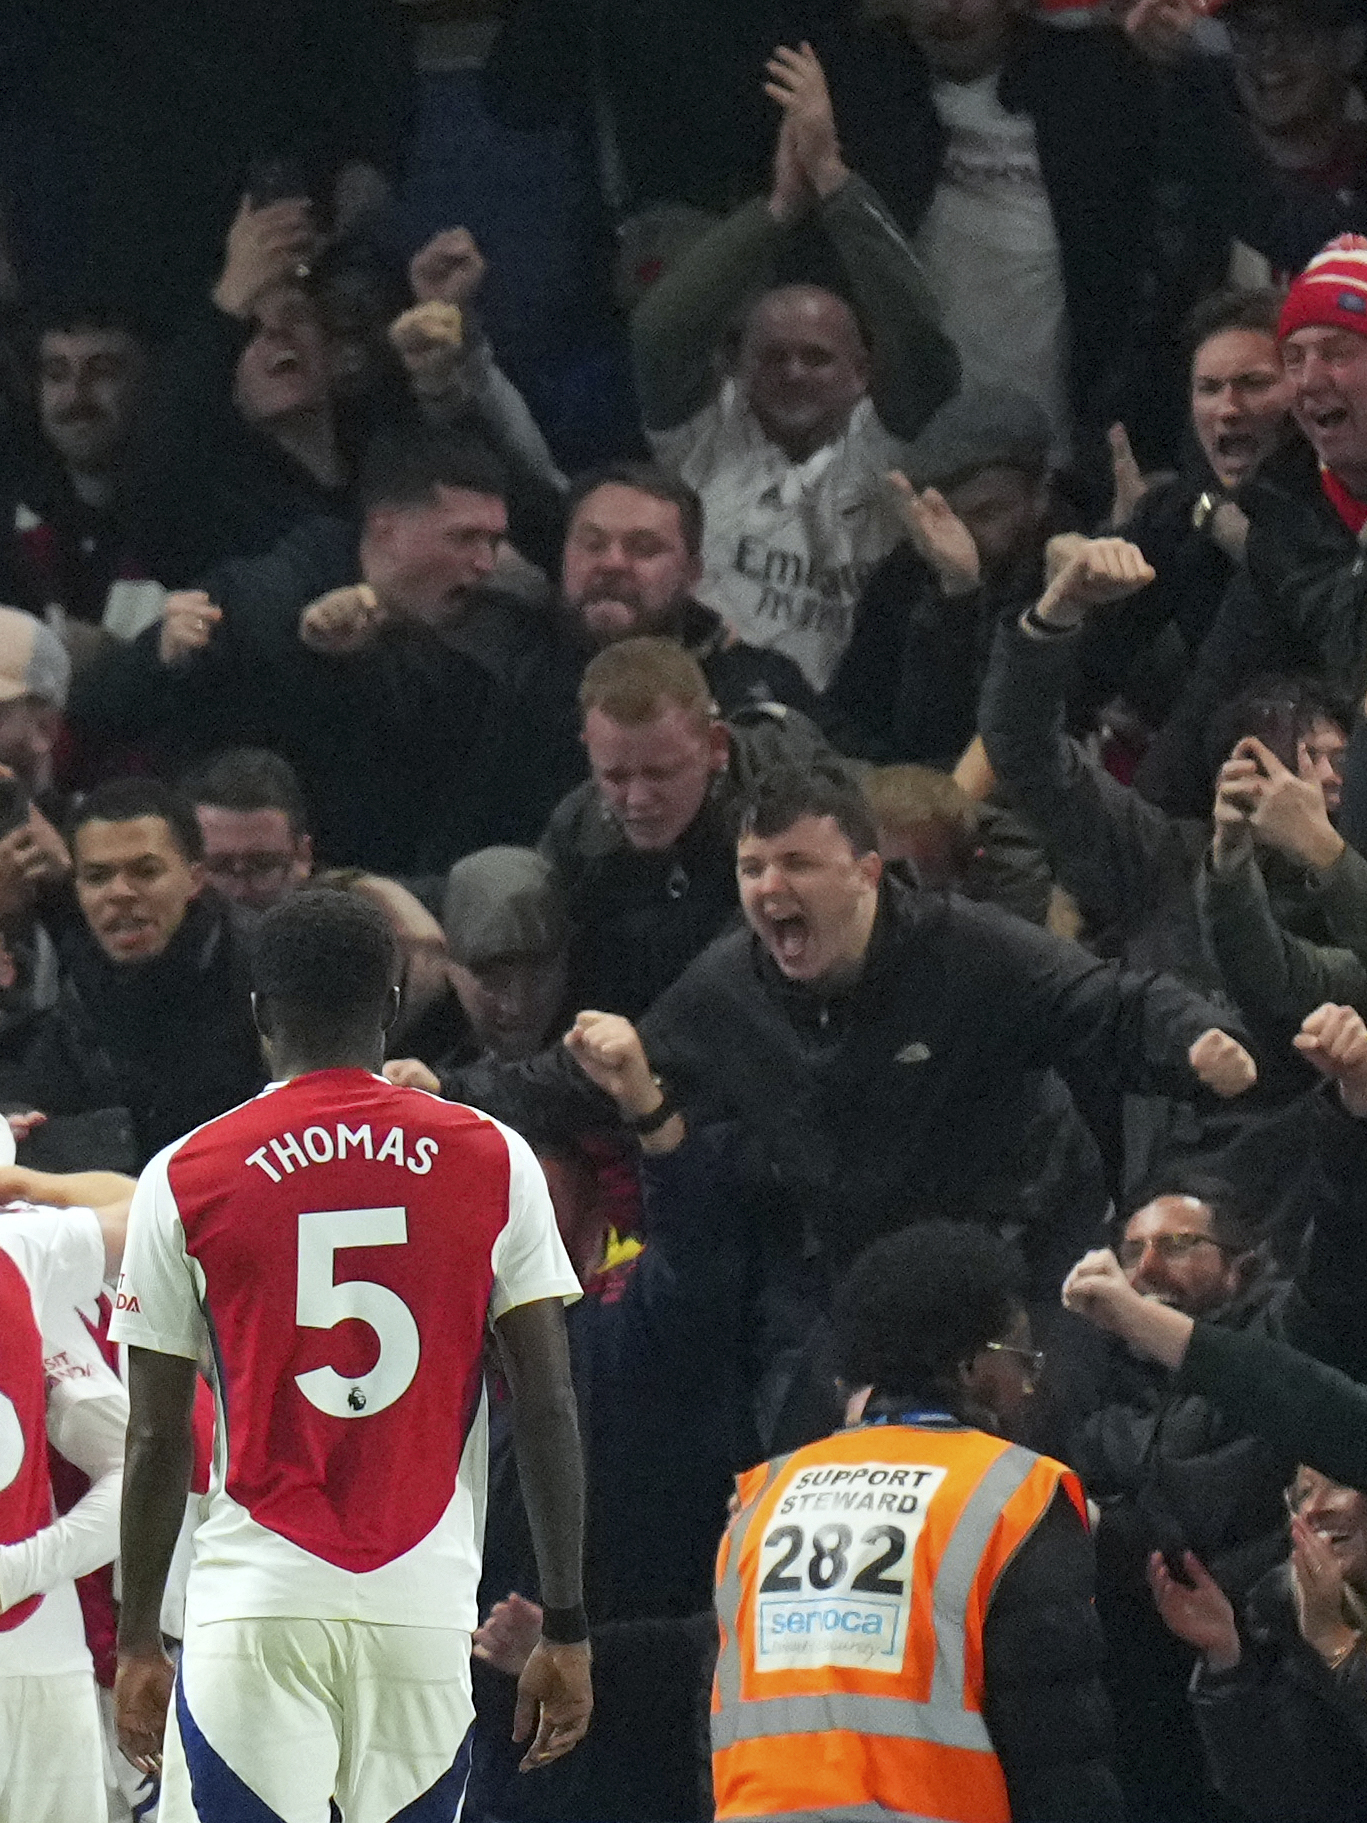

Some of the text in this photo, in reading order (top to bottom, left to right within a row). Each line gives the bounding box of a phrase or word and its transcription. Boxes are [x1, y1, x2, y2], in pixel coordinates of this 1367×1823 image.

[244, 1122, 440, 1184] THOMAS
[293, 1205, 422, 1420] 5
[780, 1492, 919, 1514] STEWARD
[795, 1467, 933, 1490] SUPPORT
[758, 1522, 907, 1596] 282
